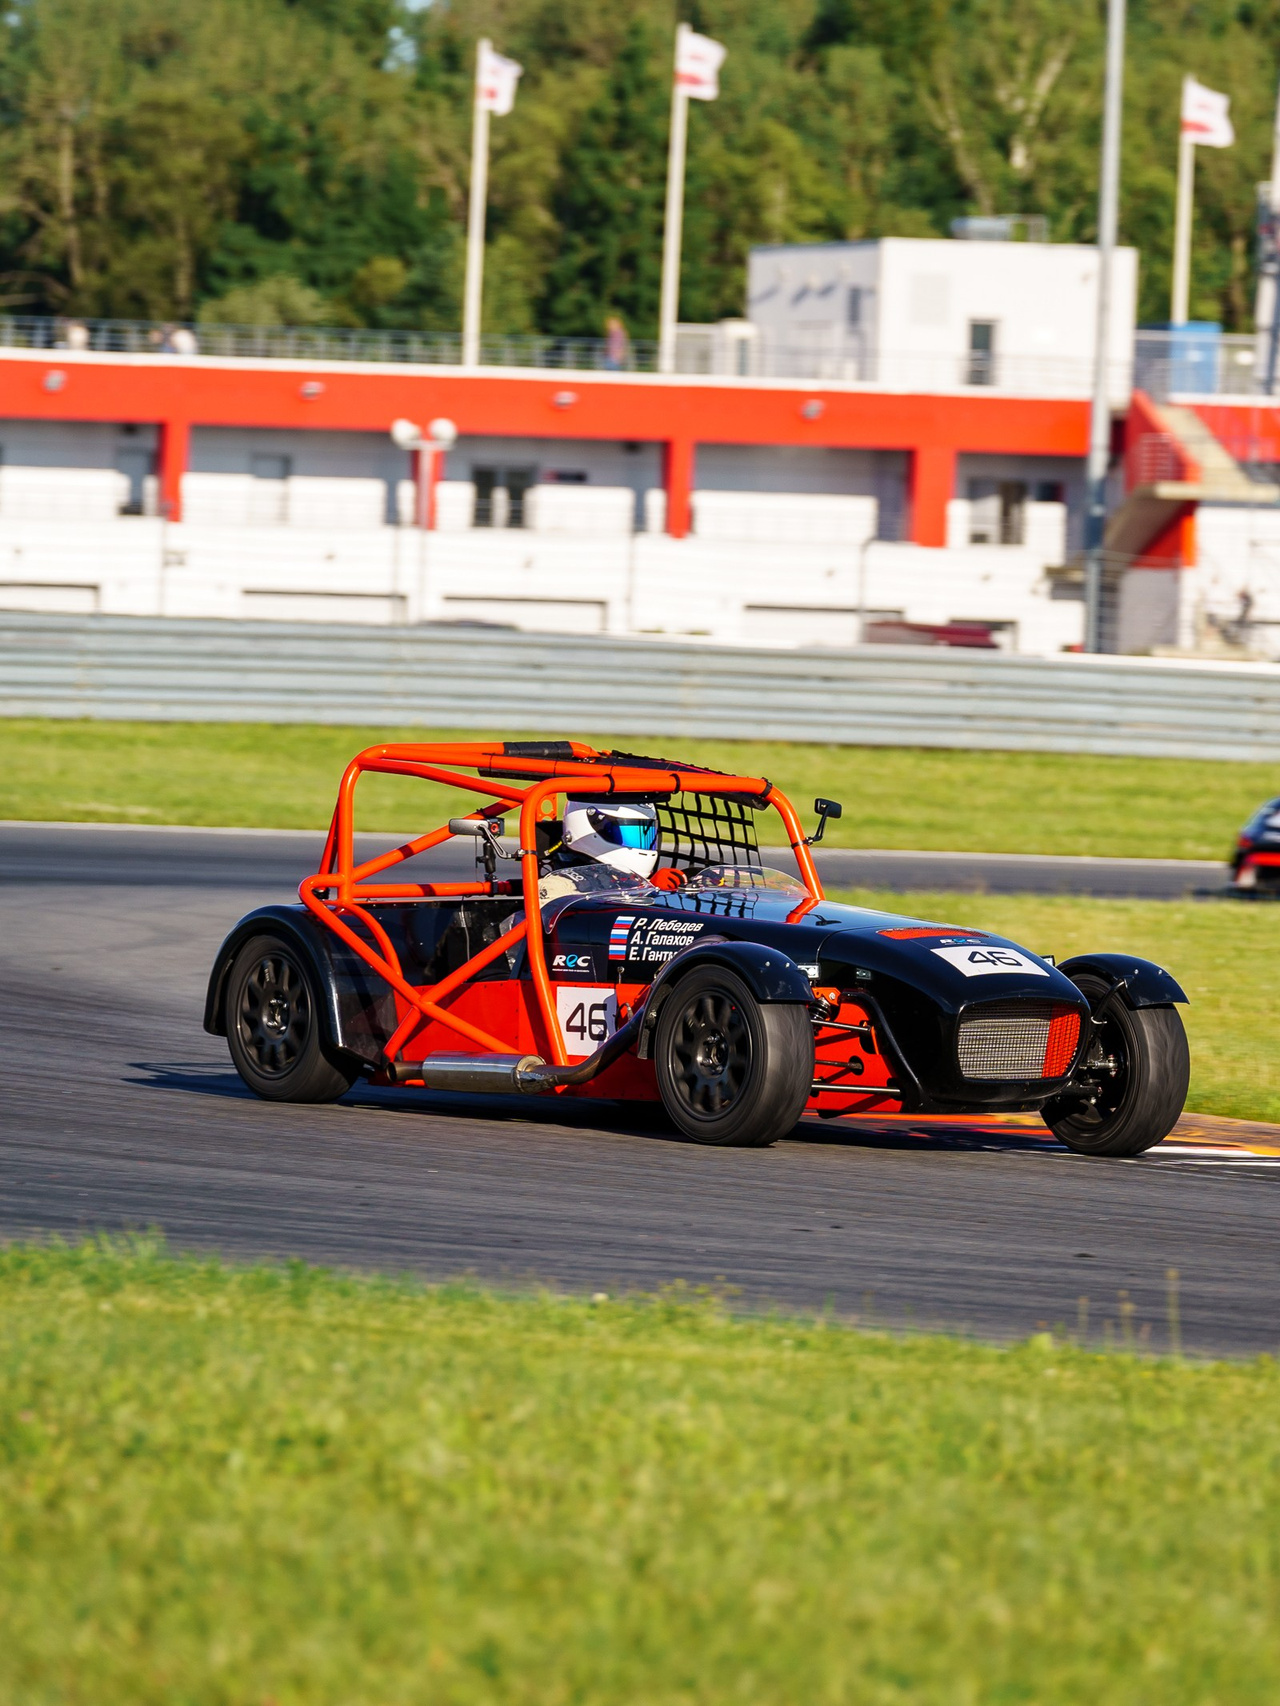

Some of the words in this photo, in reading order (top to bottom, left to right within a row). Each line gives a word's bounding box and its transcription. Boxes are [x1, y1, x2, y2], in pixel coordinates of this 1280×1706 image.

[647, 918, 704, 933] Лебедев
[645, 931, 694, 946] Галахов
[641, 946, 679, 962] Гантм
[967, 951, 1023, 967] 46
[565, 1002, 608, 1041] 46
